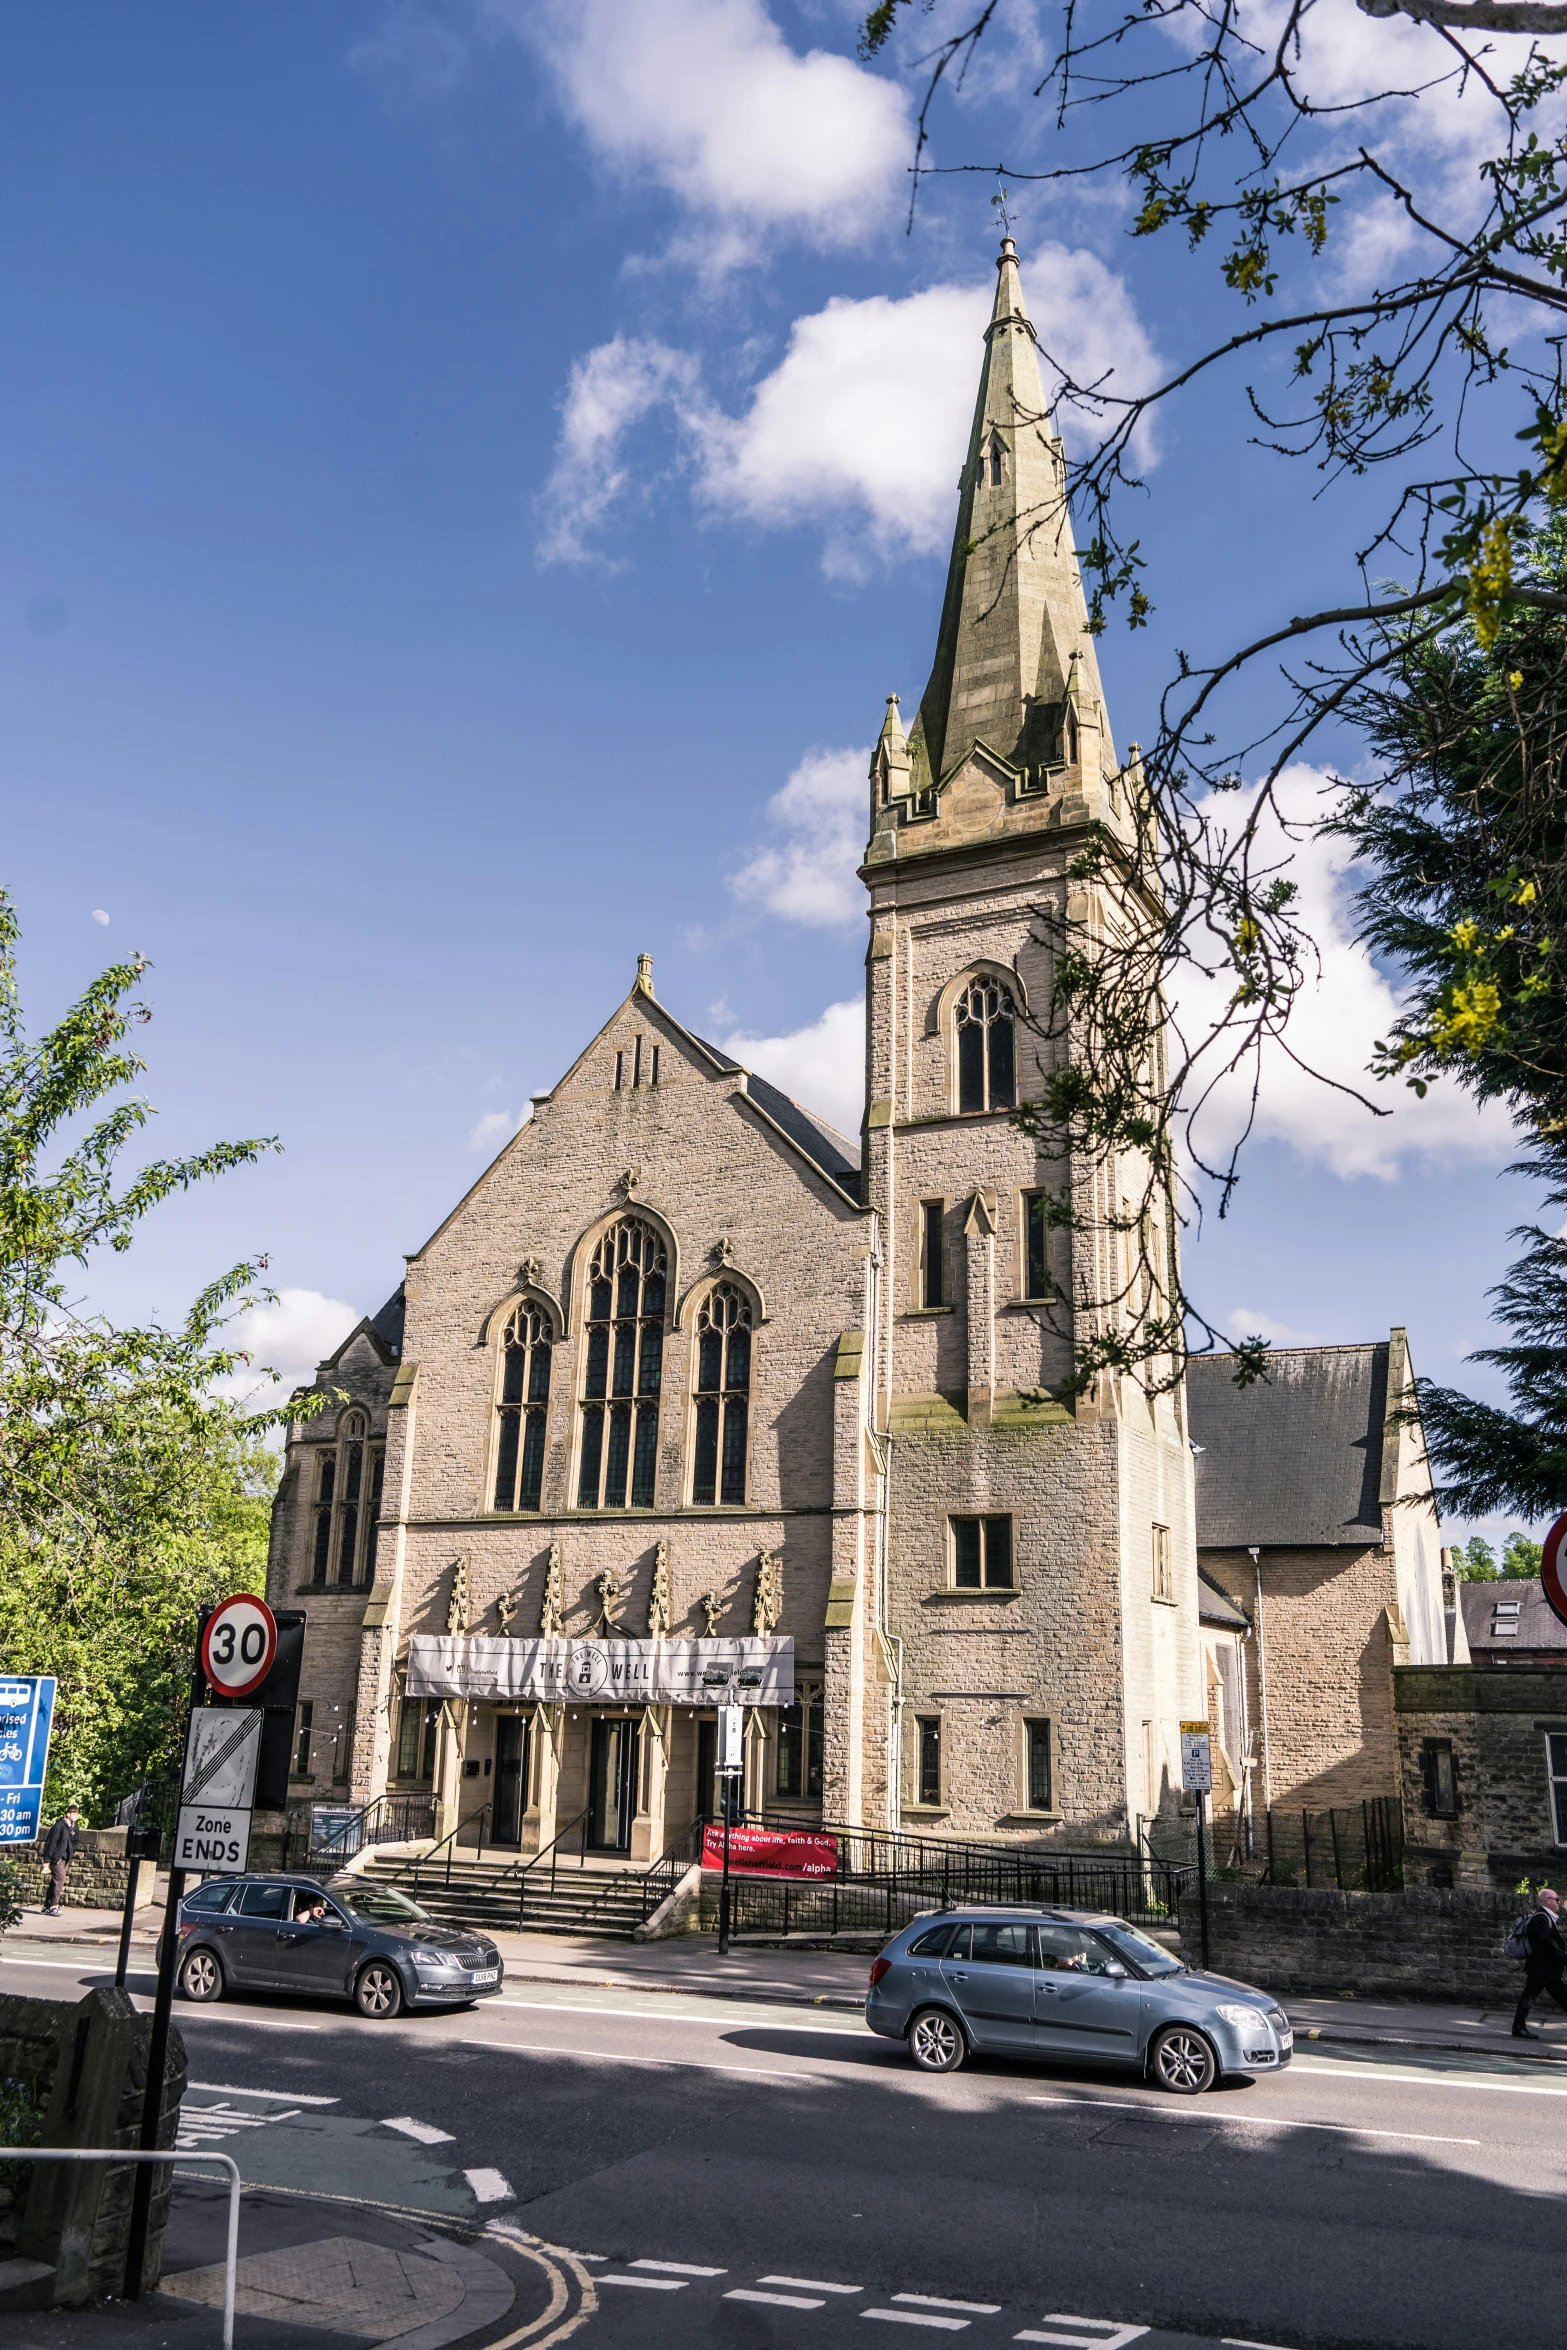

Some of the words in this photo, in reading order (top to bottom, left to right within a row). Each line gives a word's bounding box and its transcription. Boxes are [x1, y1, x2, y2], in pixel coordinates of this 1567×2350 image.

[212, 1622, 266, 1666] 30
[570, 1651, 584, 1664] THE
[585, 1650, 603, 1665] WELL
[539, 1662, 563, 1679] THE
[611, 1663, 650, 1680] WELL
[6, 1792, 21, 1805] Fri
[16, 1811, 32, 1821] am
[14, 1825, 31, 1838] pm
[195, 1815, 232, 1834] Zone
[706, 1828, 719, 1838] Ask
[720, 1830, 750, 1843] aything
[751, 1834, 771, 1844] about
[771, 1836, 786, 1845] life,
[787, 1836, 806, 1845] faith
[814, 1837, 831, 1847] God.
[706, 1839, 717, 1850] Try
[718, 1842, 737, 1850] Alha
[738, 1844, 756, 1852] here.
[181, 1838, 241, 1863] ENDS
